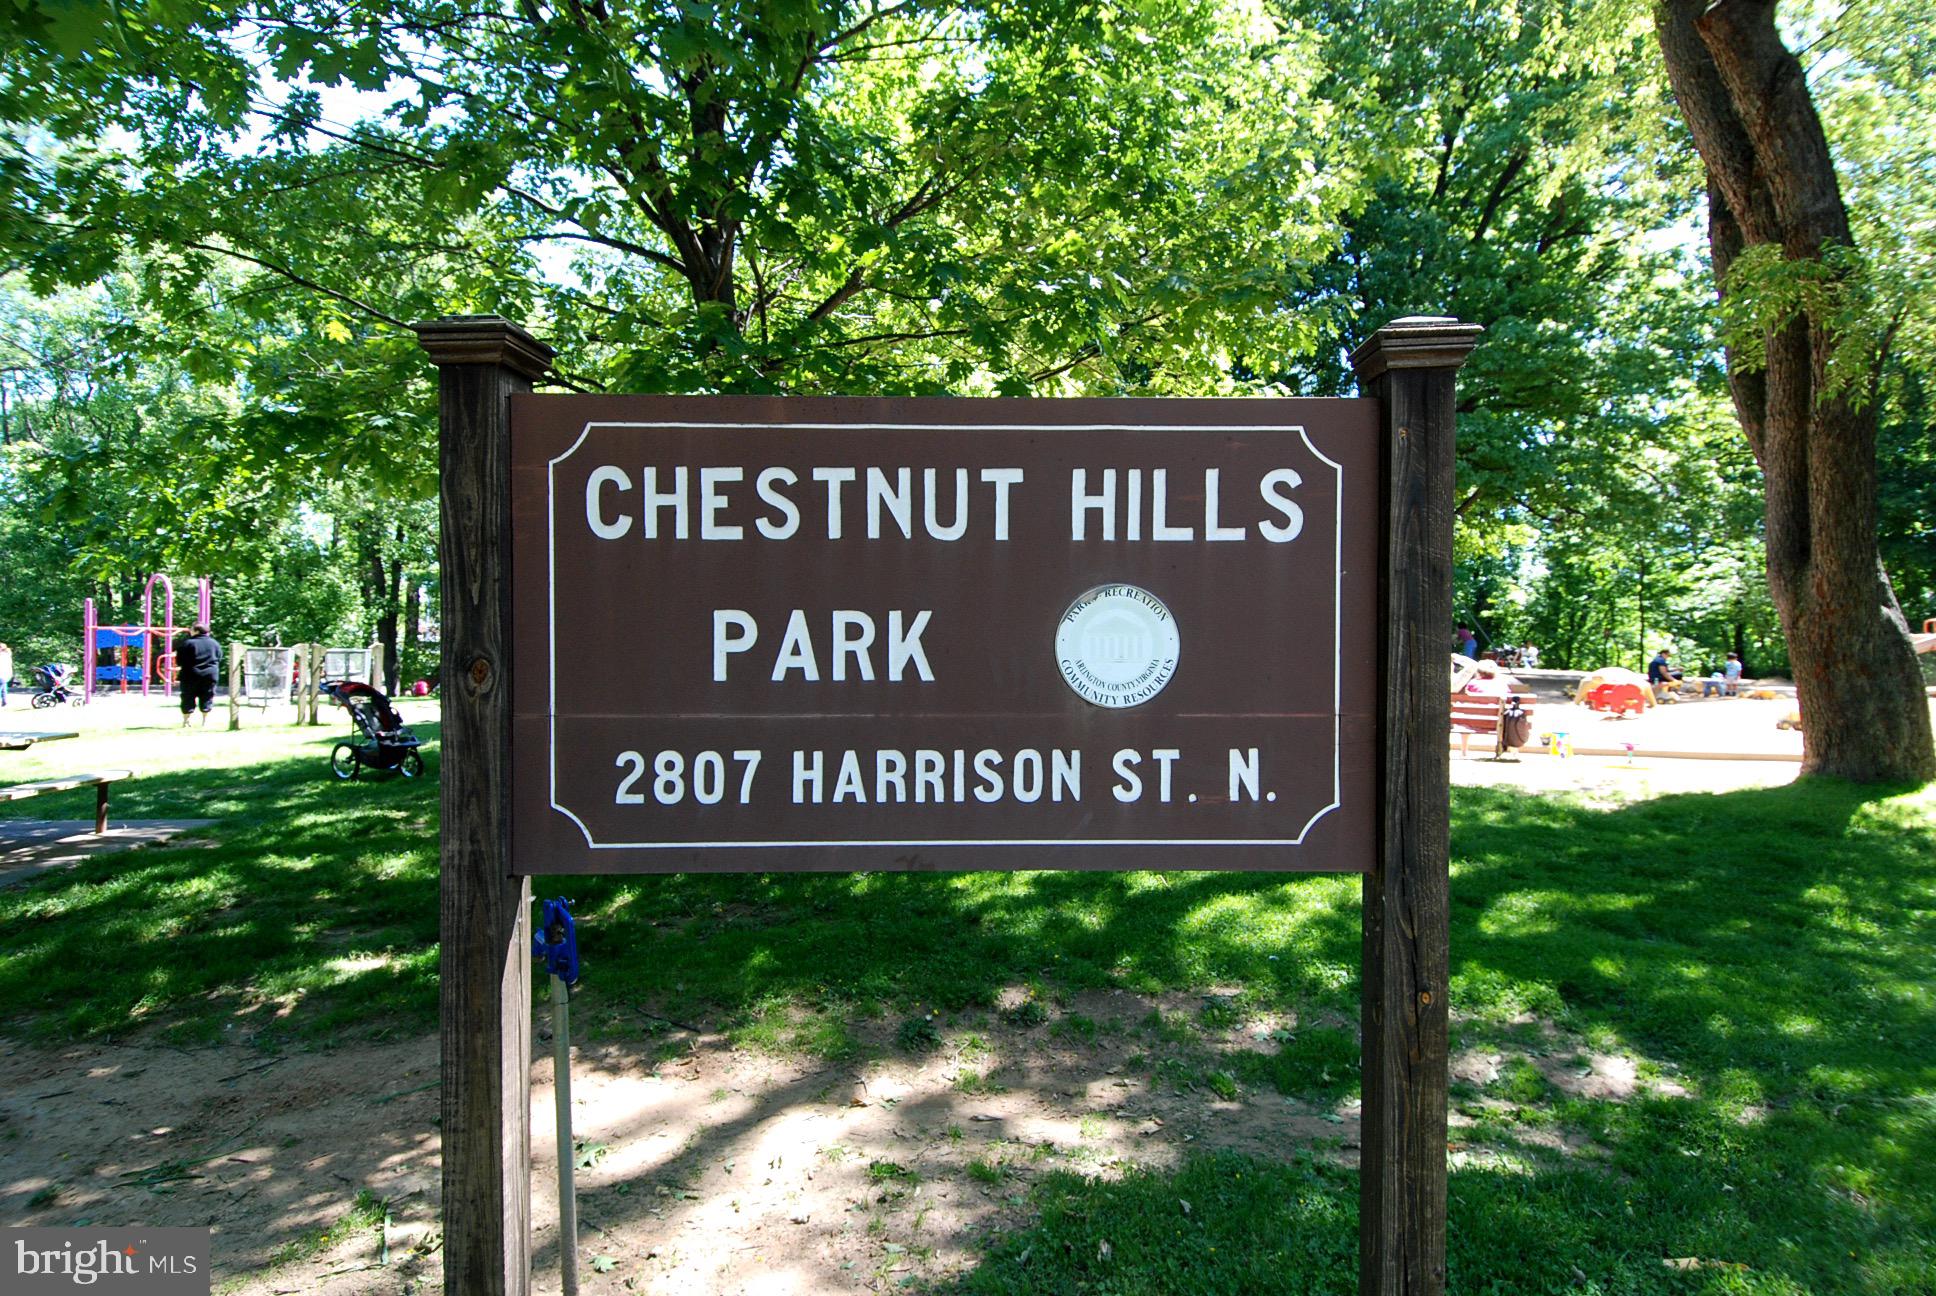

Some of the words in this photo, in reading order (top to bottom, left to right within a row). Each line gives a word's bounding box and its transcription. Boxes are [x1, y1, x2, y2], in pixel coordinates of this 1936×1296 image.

[586, 465, 1024, 541] CHESTNUT
[1071, 467, 1304, 543] HILLS
[1066, 599, 1098, 623] PARK
[1104, 588, 1169, 622] RECREATION
[713, 609, 936, 682] PARK
[1061, 659, 1119, 705] COMMUNITY
[1123, 658, 1174, 705] RESOURCES
[1074, 659, 1106, 689] ARLINGTON
[1136, 659, 1160, 685] VIRGINIA
[615, 749, 762, 805] 2807
[792, 748, 1081, 804] HARRISON
[1112, 748, 1198, 804] ST.
[1229, 747, 1277, 803] N.
